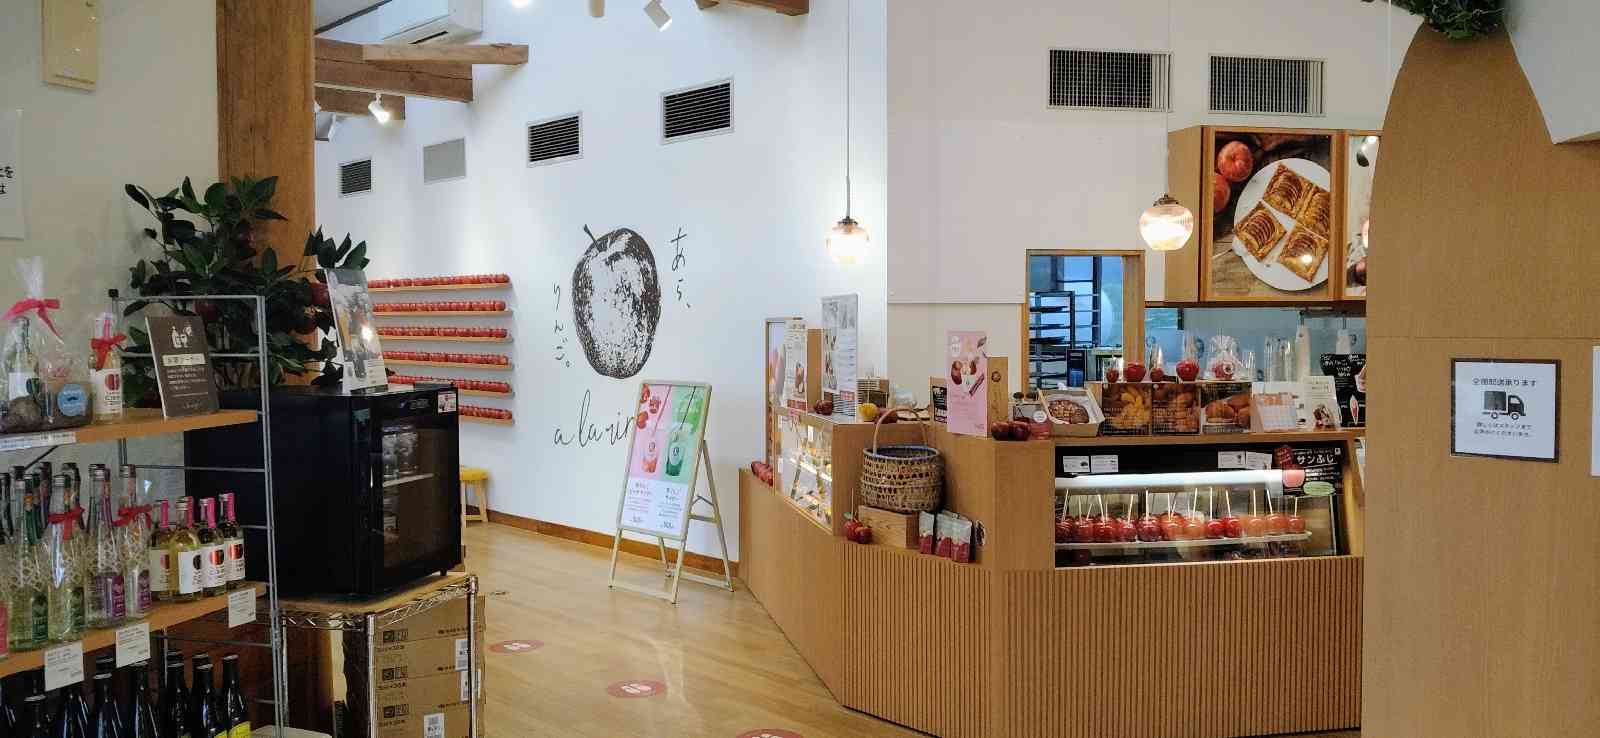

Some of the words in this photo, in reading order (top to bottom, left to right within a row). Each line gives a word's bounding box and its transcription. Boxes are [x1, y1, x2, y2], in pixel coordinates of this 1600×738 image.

[670, 226, 691, 308] あら、
[552, 283, 573, 368] りんご。
[554, 428, 575, 446] a
[579, 388, 603, 447] la
[1296, 453, 1334, 465] サンふじ
